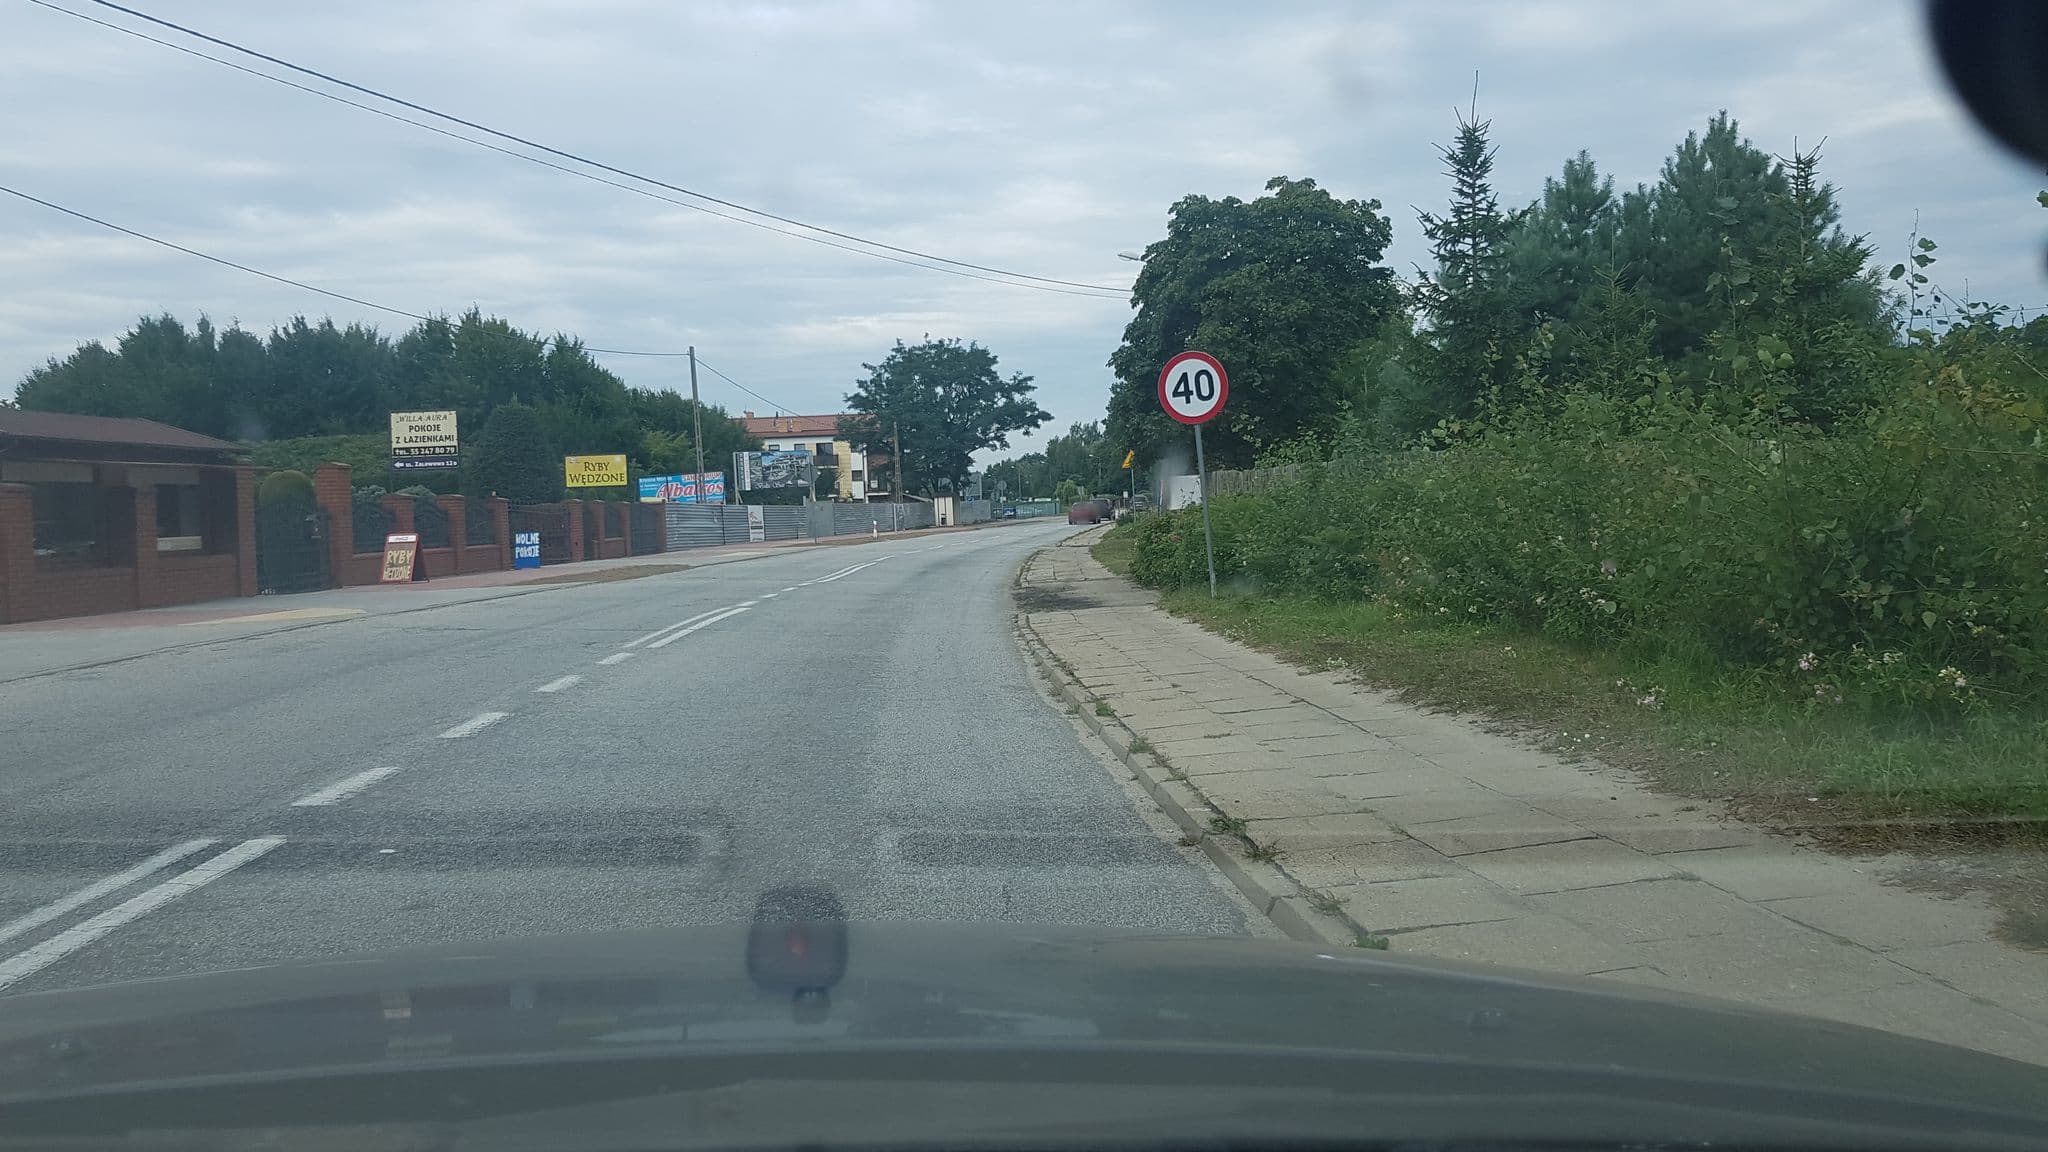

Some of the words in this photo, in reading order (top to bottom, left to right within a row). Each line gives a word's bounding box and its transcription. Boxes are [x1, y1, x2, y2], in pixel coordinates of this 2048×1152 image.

[1172, 369, 1215, 404] 40
[409, 424, 442, 433] POKOJE
[395, 436, 401, 444] Z
[403, 435, 455, 443] ŁAZIENKAMI
[420, 447, 434, 455] 247
[584, 461, 610, 472] RYBY
[569, 473, 625, 485] WĘDZONE
[656, 482, 724, 498] Albaros
[515, 533, 540, 545] WOLNE
[387, 550, 413, 565] RYBY
